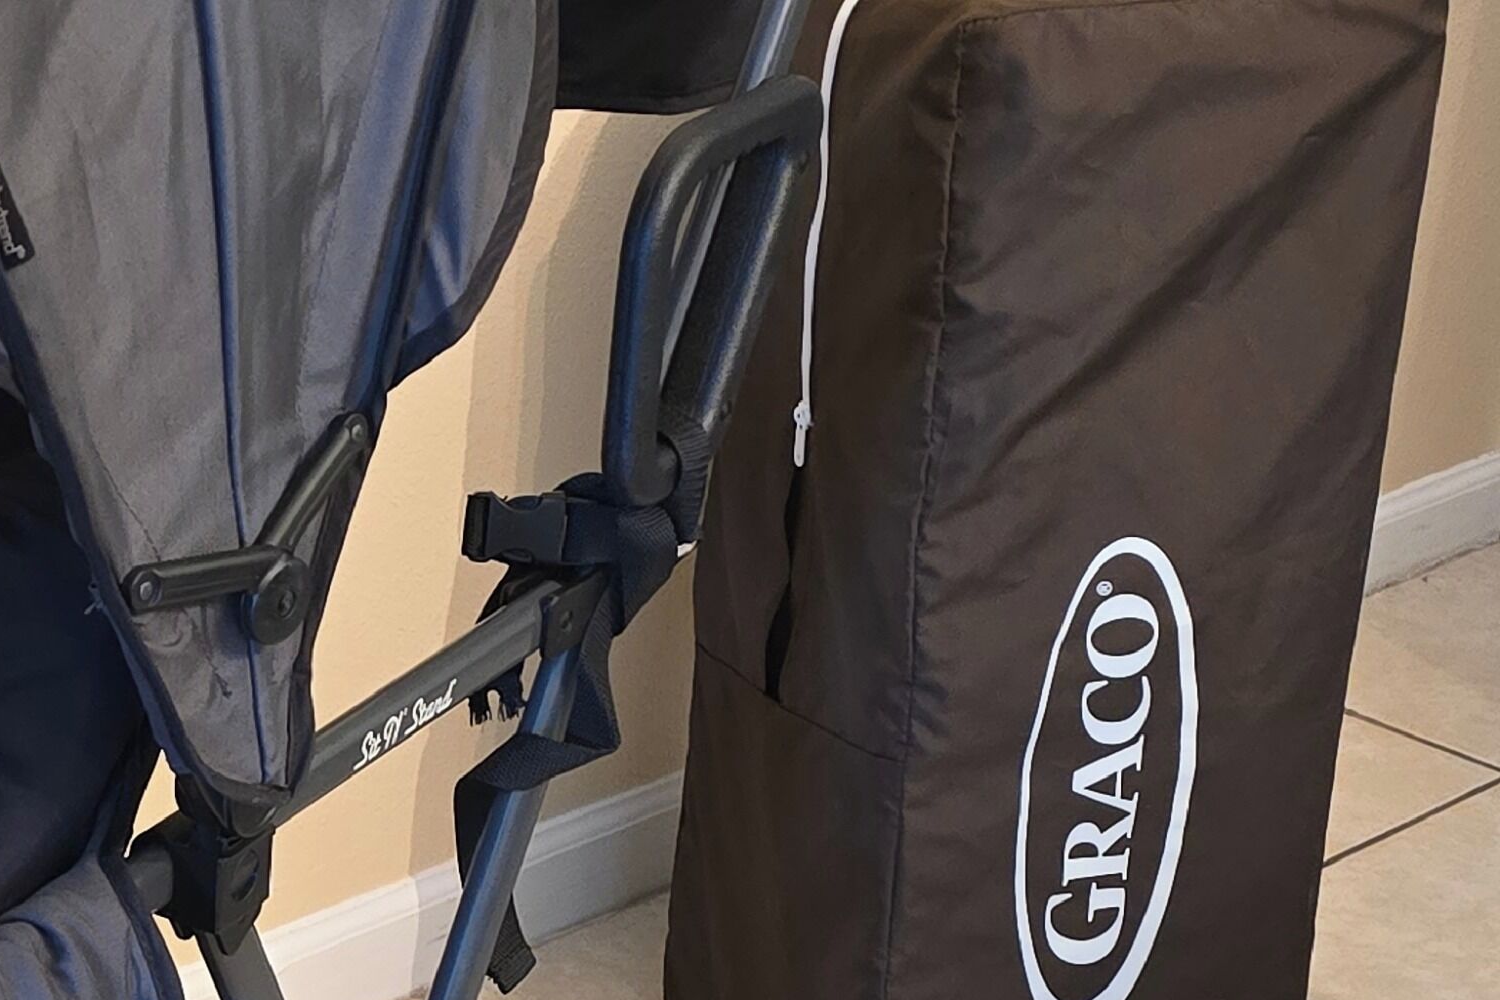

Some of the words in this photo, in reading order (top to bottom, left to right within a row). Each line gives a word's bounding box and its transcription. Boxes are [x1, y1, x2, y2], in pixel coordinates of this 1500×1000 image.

[352, 730, 382, 772] Sit
[404, 678, 457, 736] Stand
[1044, 593, 1160, 965] GRACO
